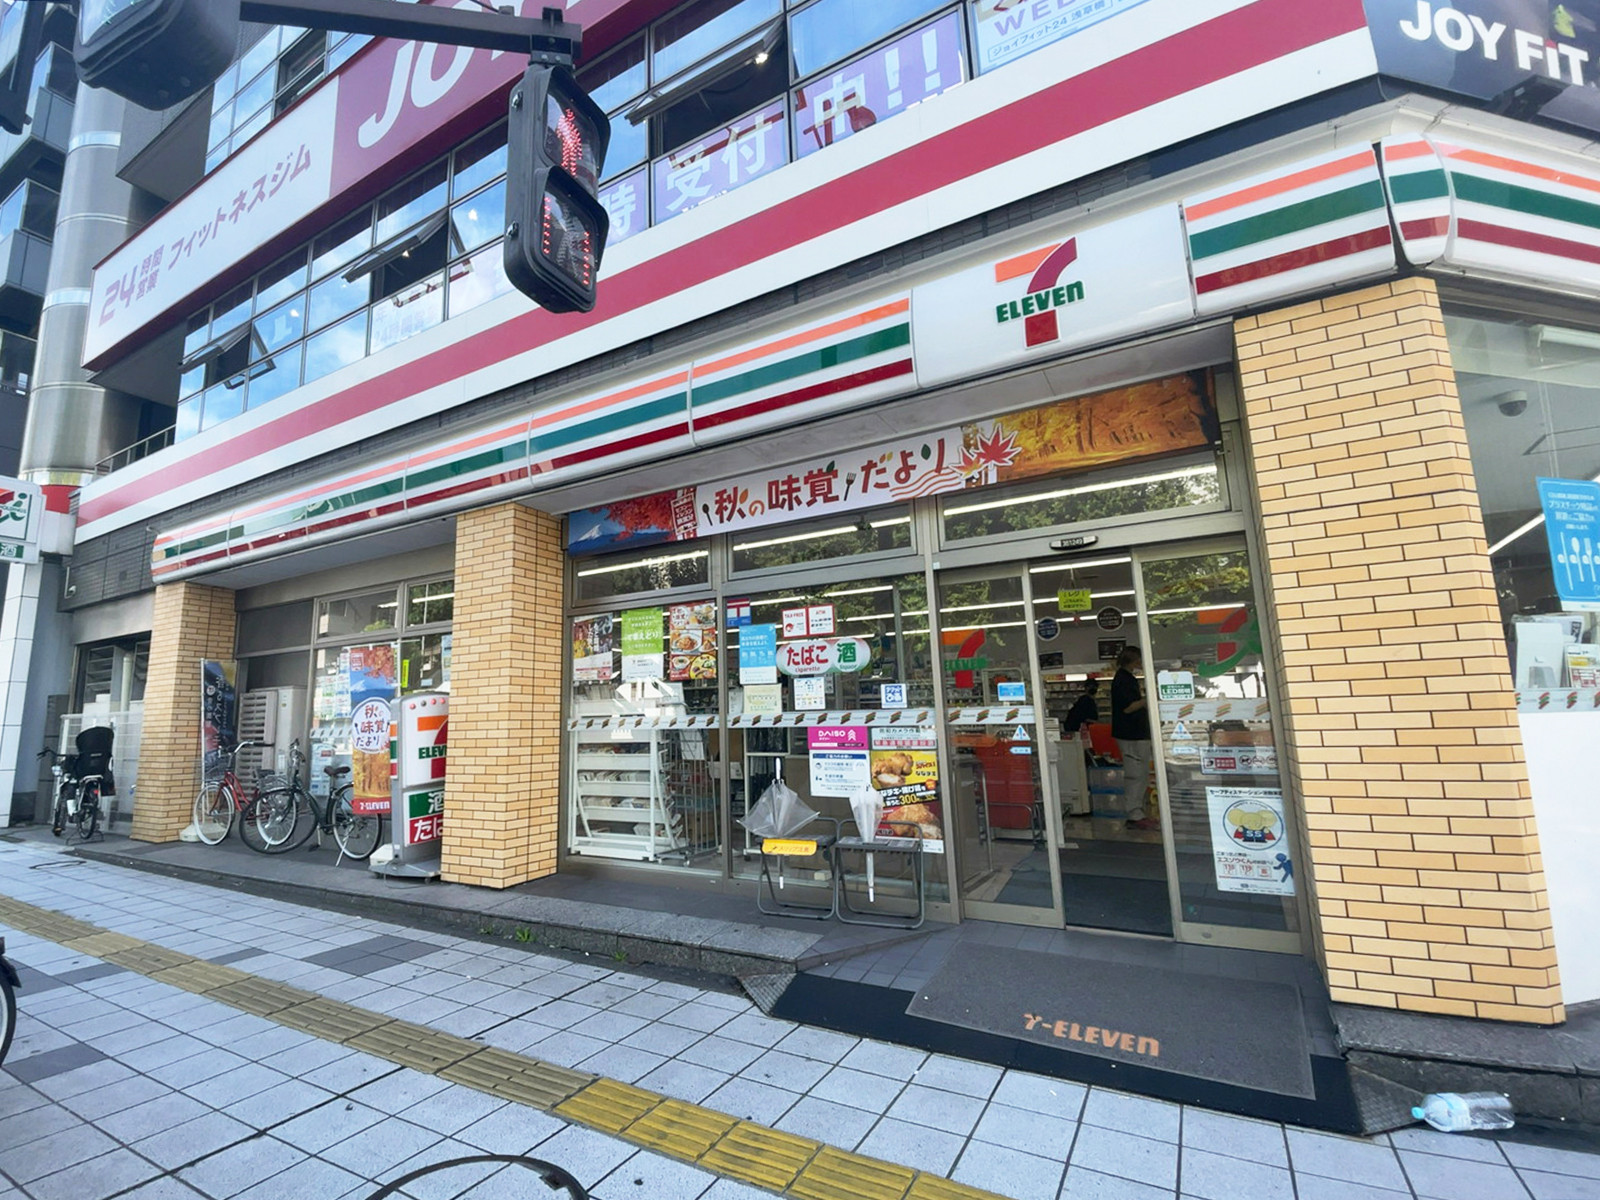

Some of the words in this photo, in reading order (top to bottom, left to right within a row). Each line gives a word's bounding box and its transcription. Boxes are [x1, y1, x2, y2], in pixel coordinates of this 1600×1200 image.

[1399, 0, 1507, 61] JOY
[168, 143, 312, 271] フィットネスジム
[99, 265, 138, 328] 24
[787, 645, 829, 666] たばこ
[837, 642, 857, 663] 酒
[818, 730, 846, 738] DAISO
